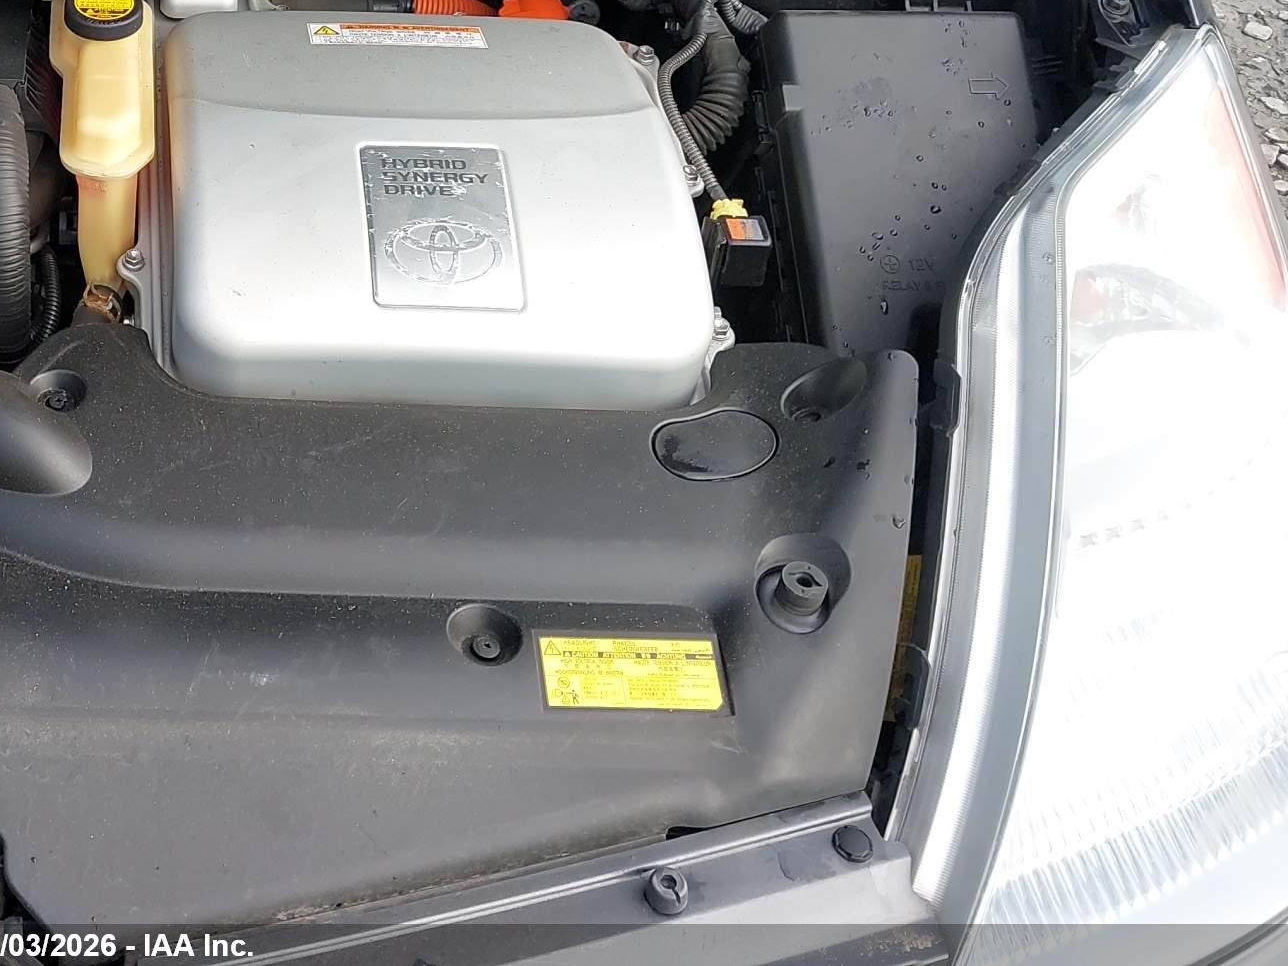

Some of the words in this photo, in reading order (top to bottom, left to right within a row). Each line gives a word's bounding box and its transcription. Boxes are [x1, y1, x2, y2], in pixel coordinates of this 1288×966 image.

[380, 158, 467, 170] HYBRID
[381, 171, 489, 184] SYNERGY
[383, 184, 453, 196] DRIVE
